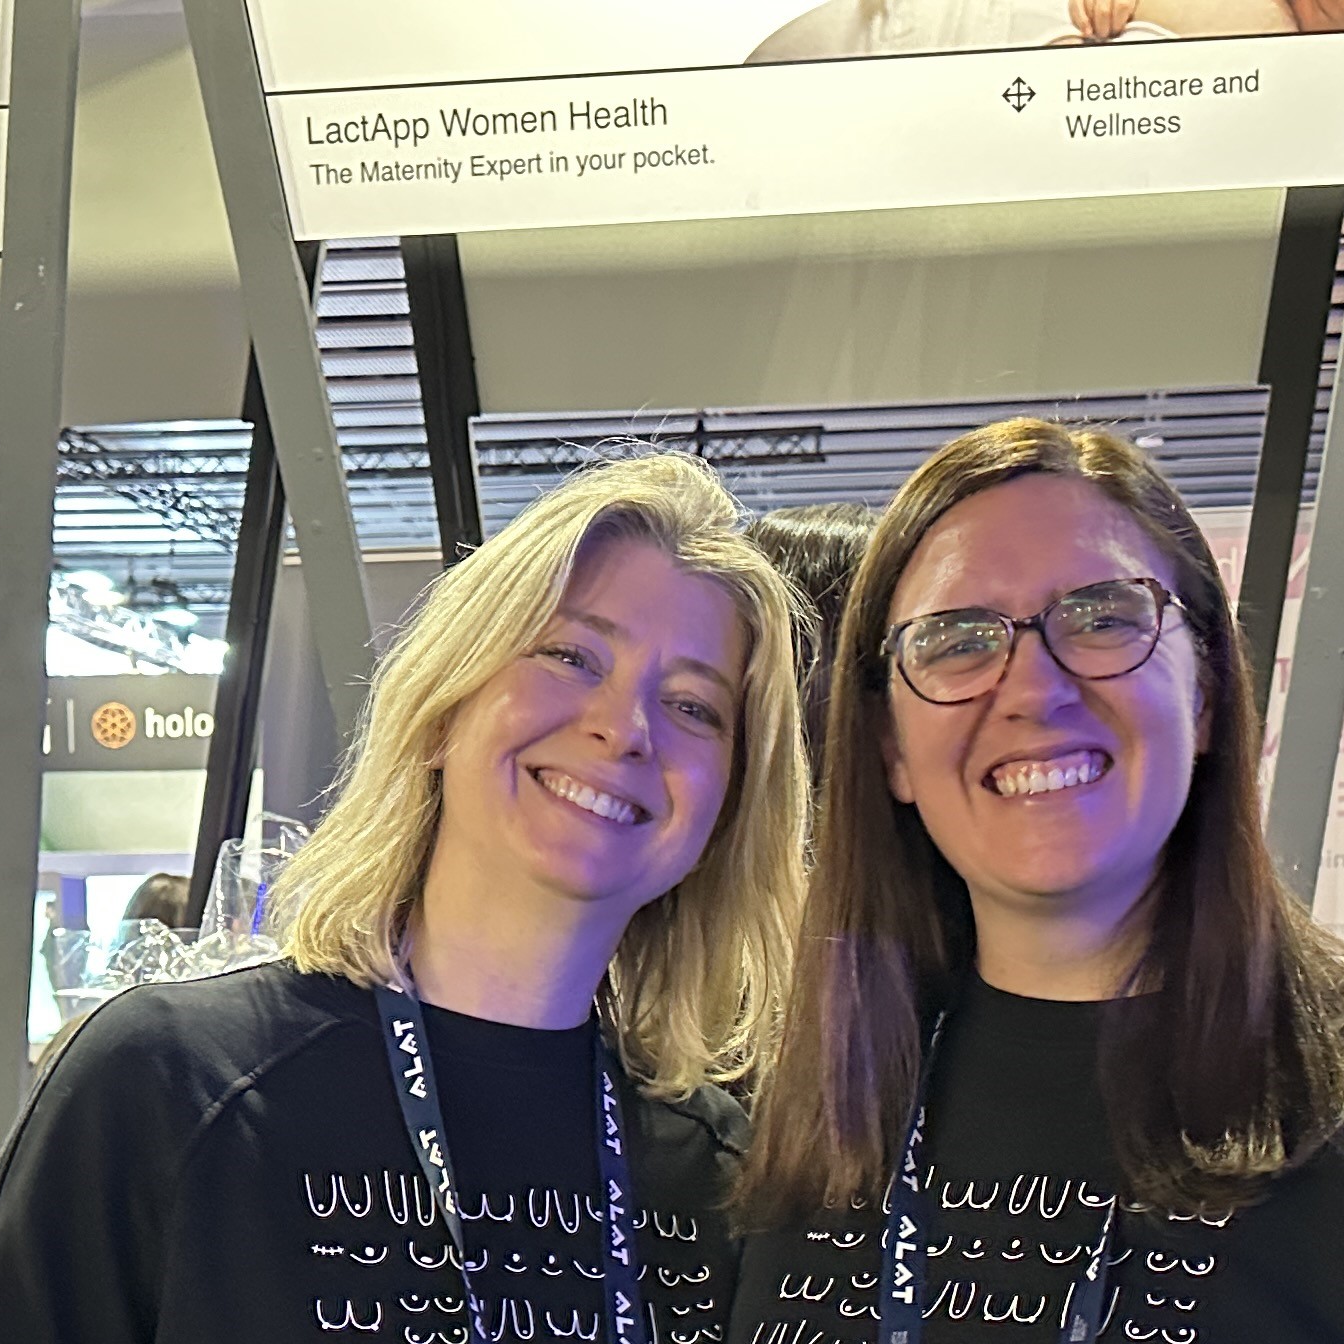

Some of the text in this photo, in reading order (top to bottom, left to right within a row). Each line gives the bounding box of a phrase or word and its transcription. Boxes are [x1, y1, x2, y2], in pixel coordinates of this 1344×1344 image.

[1066, 69, 1259, 102] Healthcare and
[306, 97, 668, 147] LactApp Women Health
[1065, 112, 1181, 138] Wellness
[310, 144, 715, 186] The Maternity Expert in your pocket.
[145, 706, 215, 738] holo
[392, 1019, 428, 1099] ALAT
[609, 1179, 630, 1266] ALAT
[891, 1215, 917, 1304] ALAT
